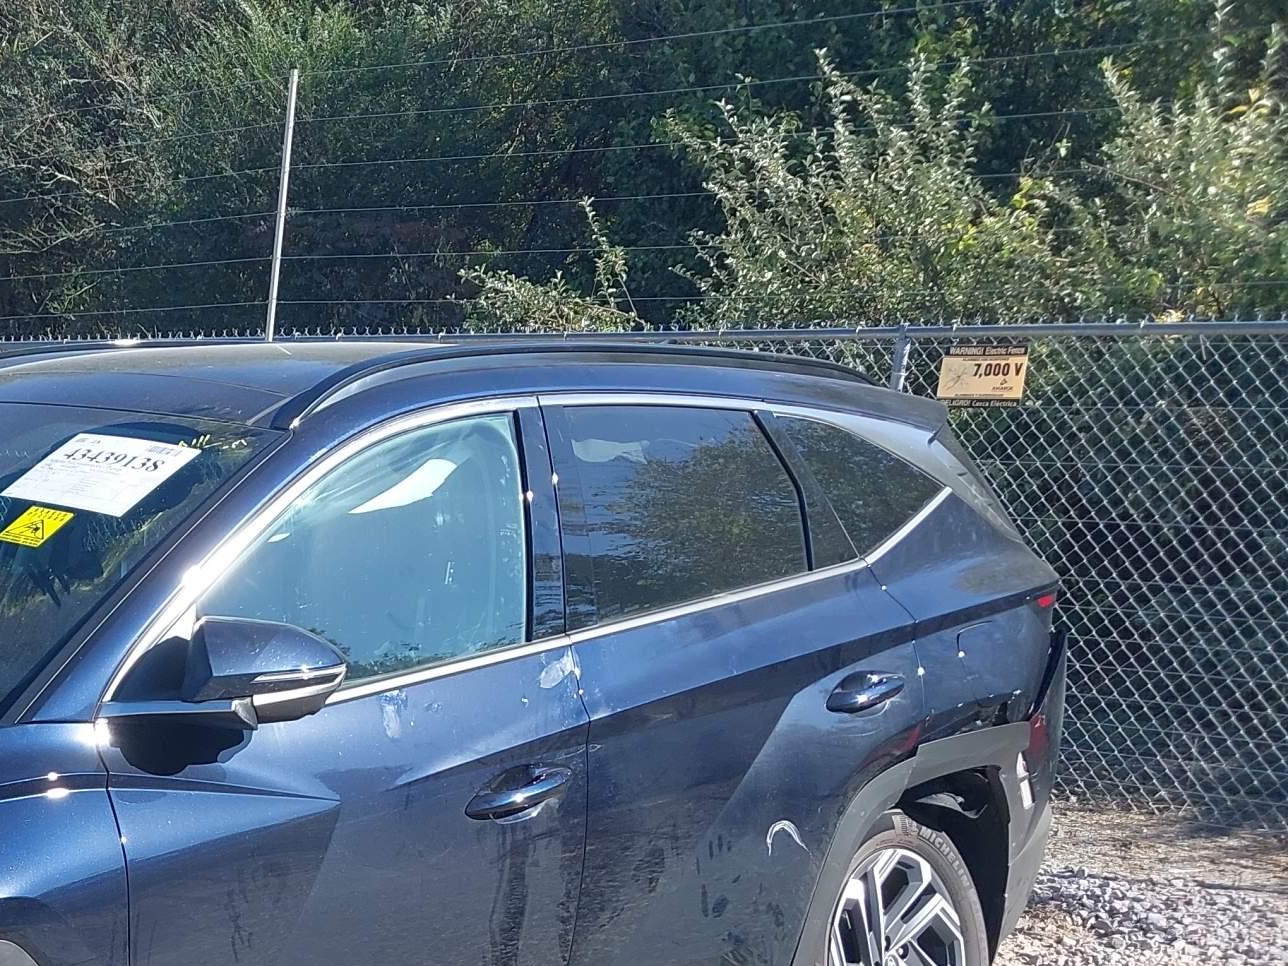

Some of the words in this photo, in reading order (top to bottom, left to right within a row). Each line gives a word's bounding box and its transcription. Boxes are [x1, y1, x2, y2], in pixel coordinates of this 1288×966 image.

[950, 346, 984, 355] WARNING!
[972, 363, 1011, 379] 7,000
[1014, 363, 1023, 376] V
[64, 447, 165, 473] 43439138
